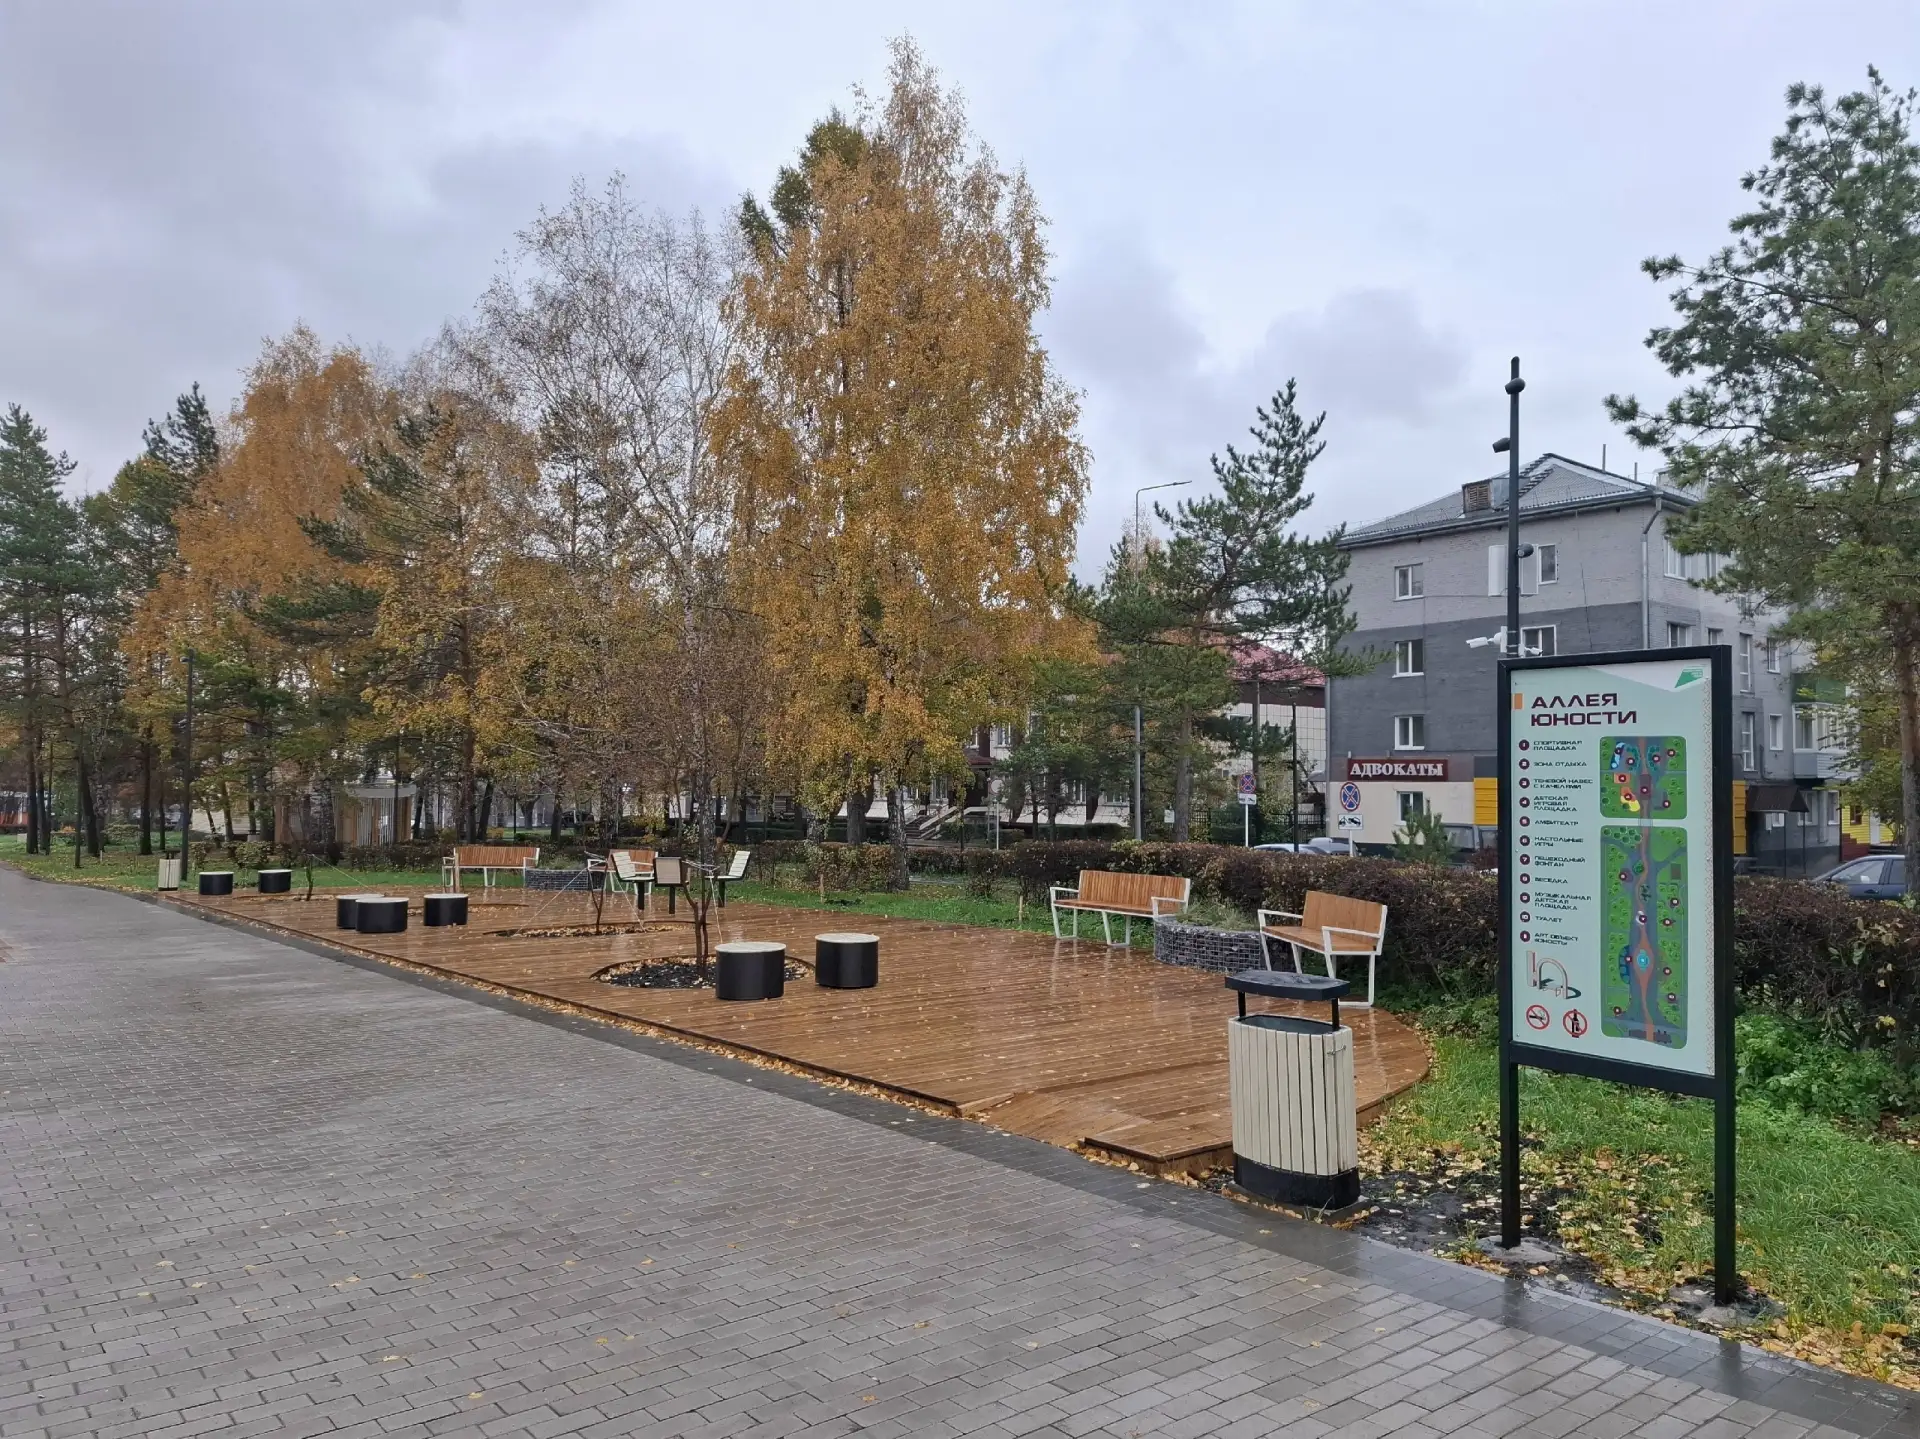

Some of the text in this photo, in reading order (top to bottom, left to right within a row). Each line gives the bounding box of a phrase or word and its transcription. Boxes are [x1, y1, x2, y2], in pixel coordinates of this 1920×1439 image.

[1531, 693, 1618, 709] АЛЛЕЯ
[1531, 711, 1637, 727] ЮНОСТИ
[1350, 762, 1443, 778] АДВОКАТЫ
